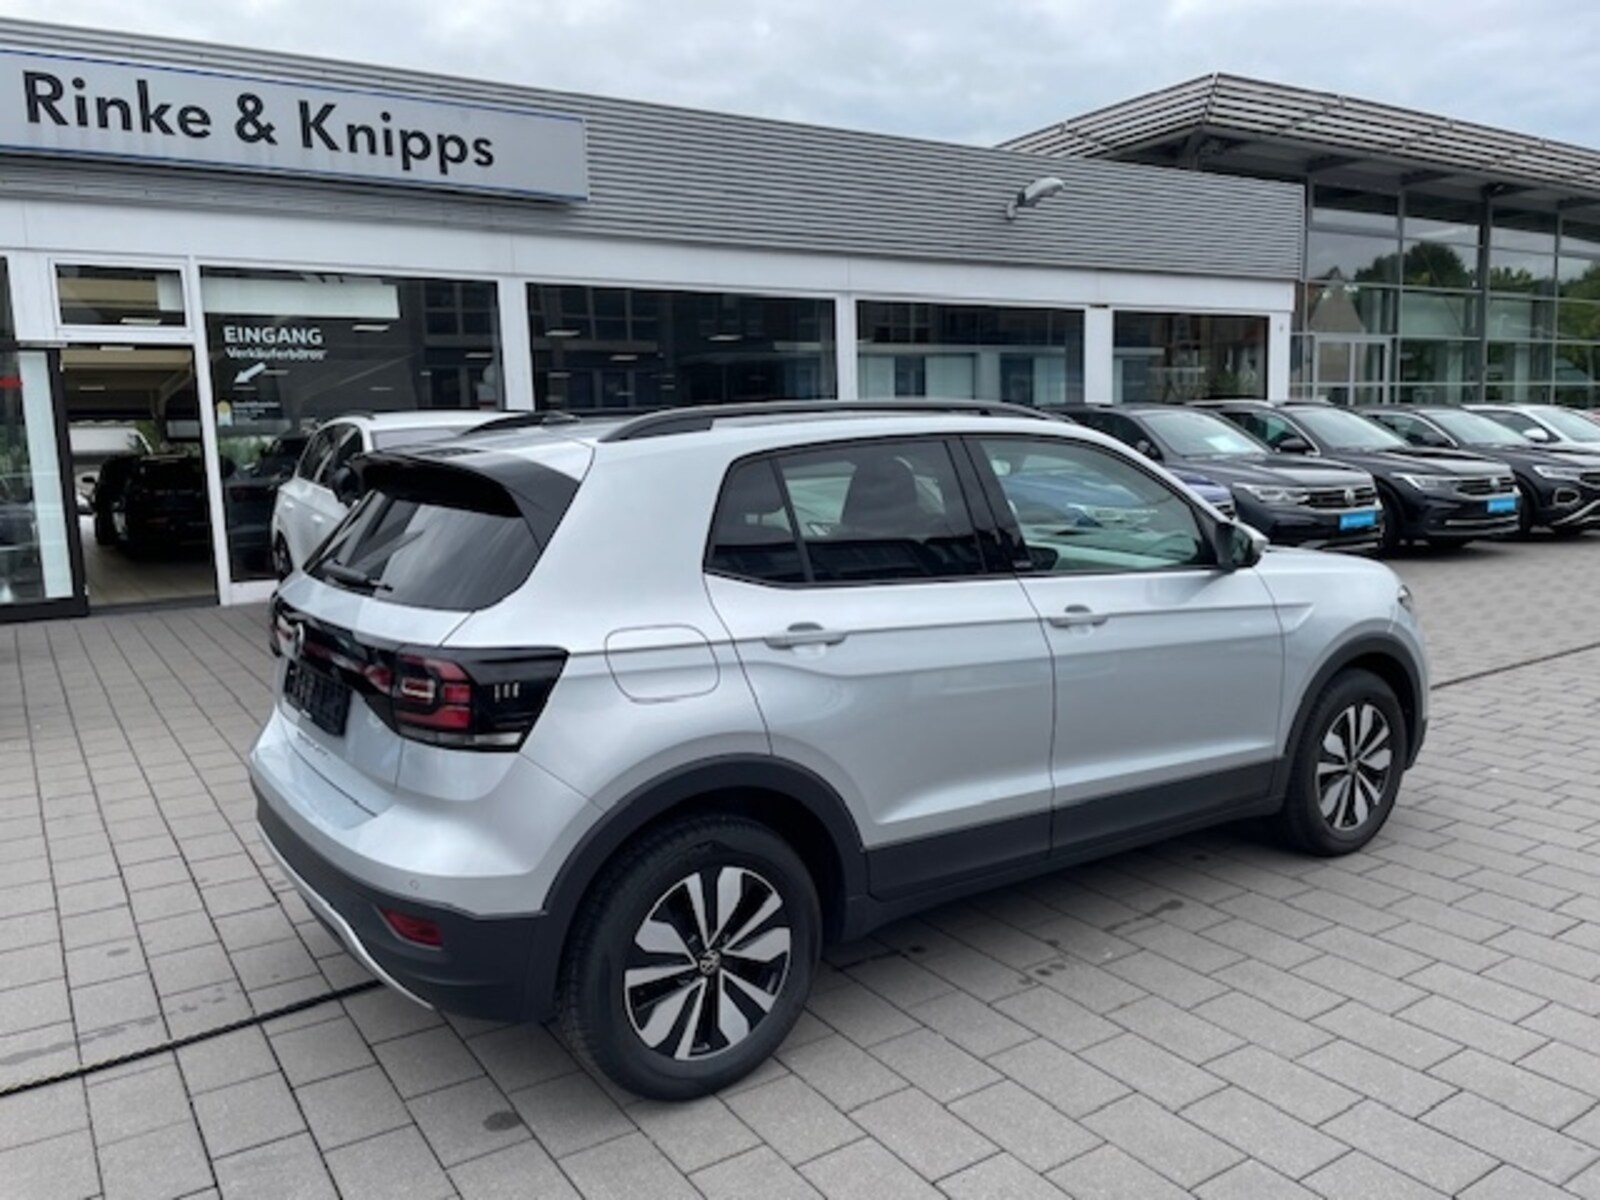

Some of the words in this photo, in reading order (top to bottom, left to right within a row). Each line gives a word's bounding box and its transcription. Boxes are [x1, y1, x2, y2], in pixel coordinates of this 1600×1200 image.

[22, 70, 212, 139] Rinke
[234, 92, 278, 146] &
[298, 99, 495, 175] Knipps
[223, 326, 323, 345] EINGANG
